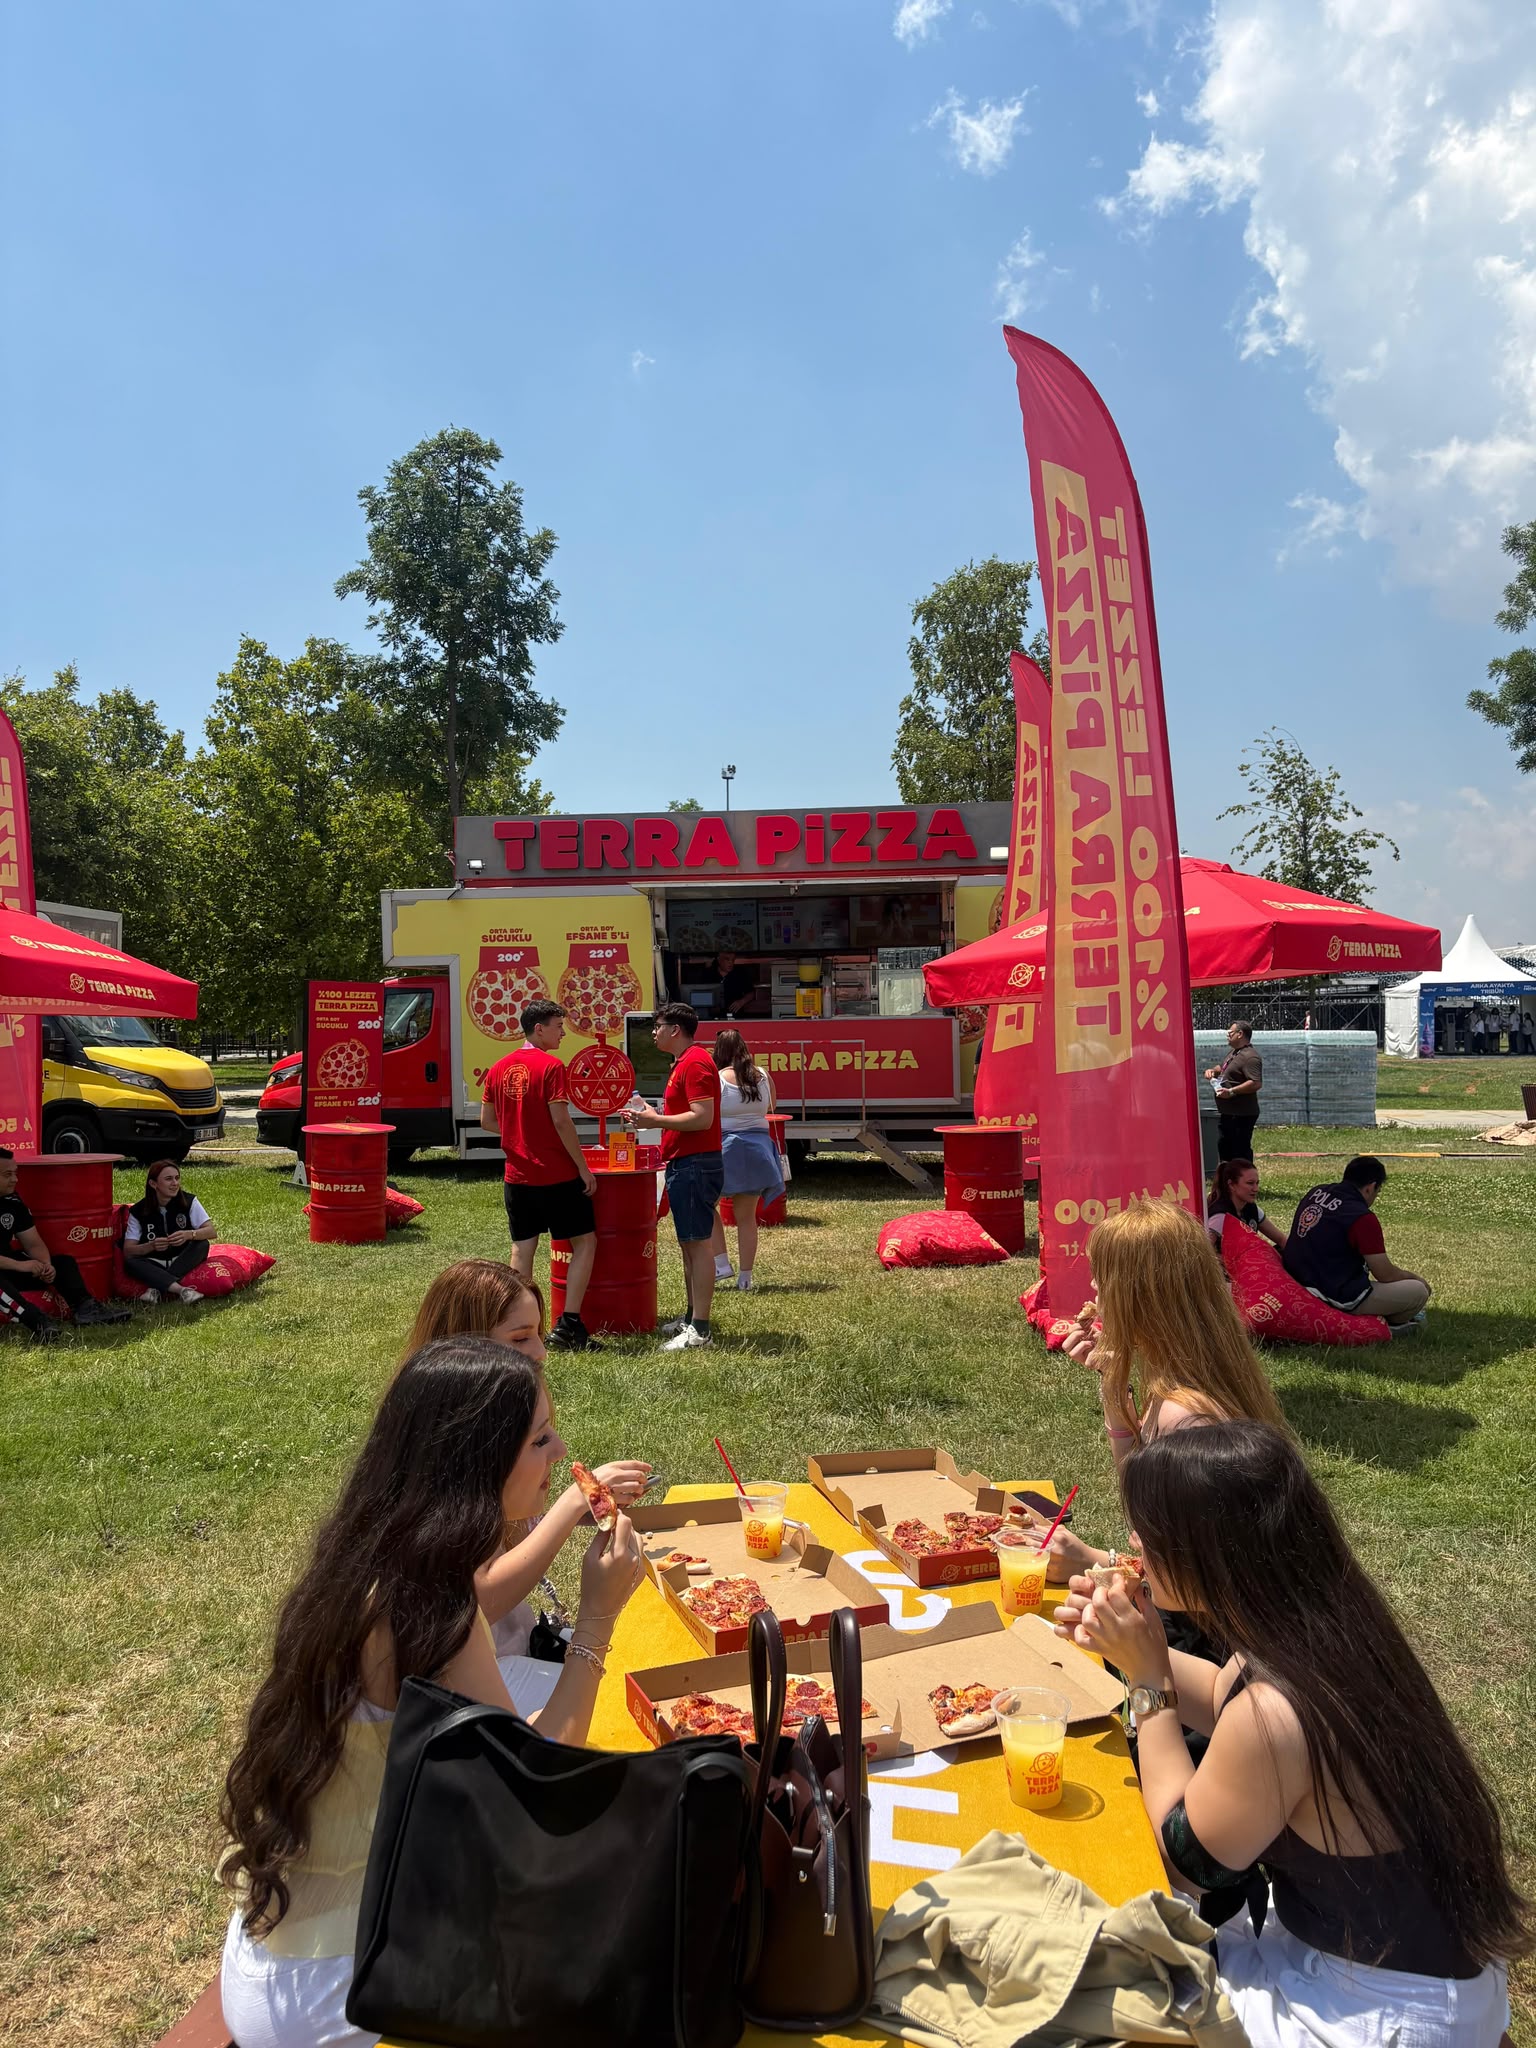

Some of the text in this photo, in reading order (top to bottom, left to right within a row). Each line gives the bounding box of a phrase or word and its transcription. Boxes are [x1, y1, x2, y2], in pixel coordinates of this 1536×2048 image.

[493, 816, 741, 871] TERRA
[481, 934, 532, 943] SUCUKLU
[566, 932, 607, 941] EFSANE
[1343, 941, 1374, 957] TERRA
[87, 979, 125, 995] TERRA
[318, 990, 376, 999] %100 LEZZET
[319, 1002, 347, 1010] TERRA
[751, 1052, 830, 1072] ERRA
[979, 1190, 1014, 1199] TERRA
[91, 1227, 114, 1239] TERR
[746, 1534, 769, 1543] TERRA
[963, 1563, 999, 1576] TERR
[1015, 1591, 1042, 1599] TERRA
[1025, 1772, 1060, 1785] TERRA
